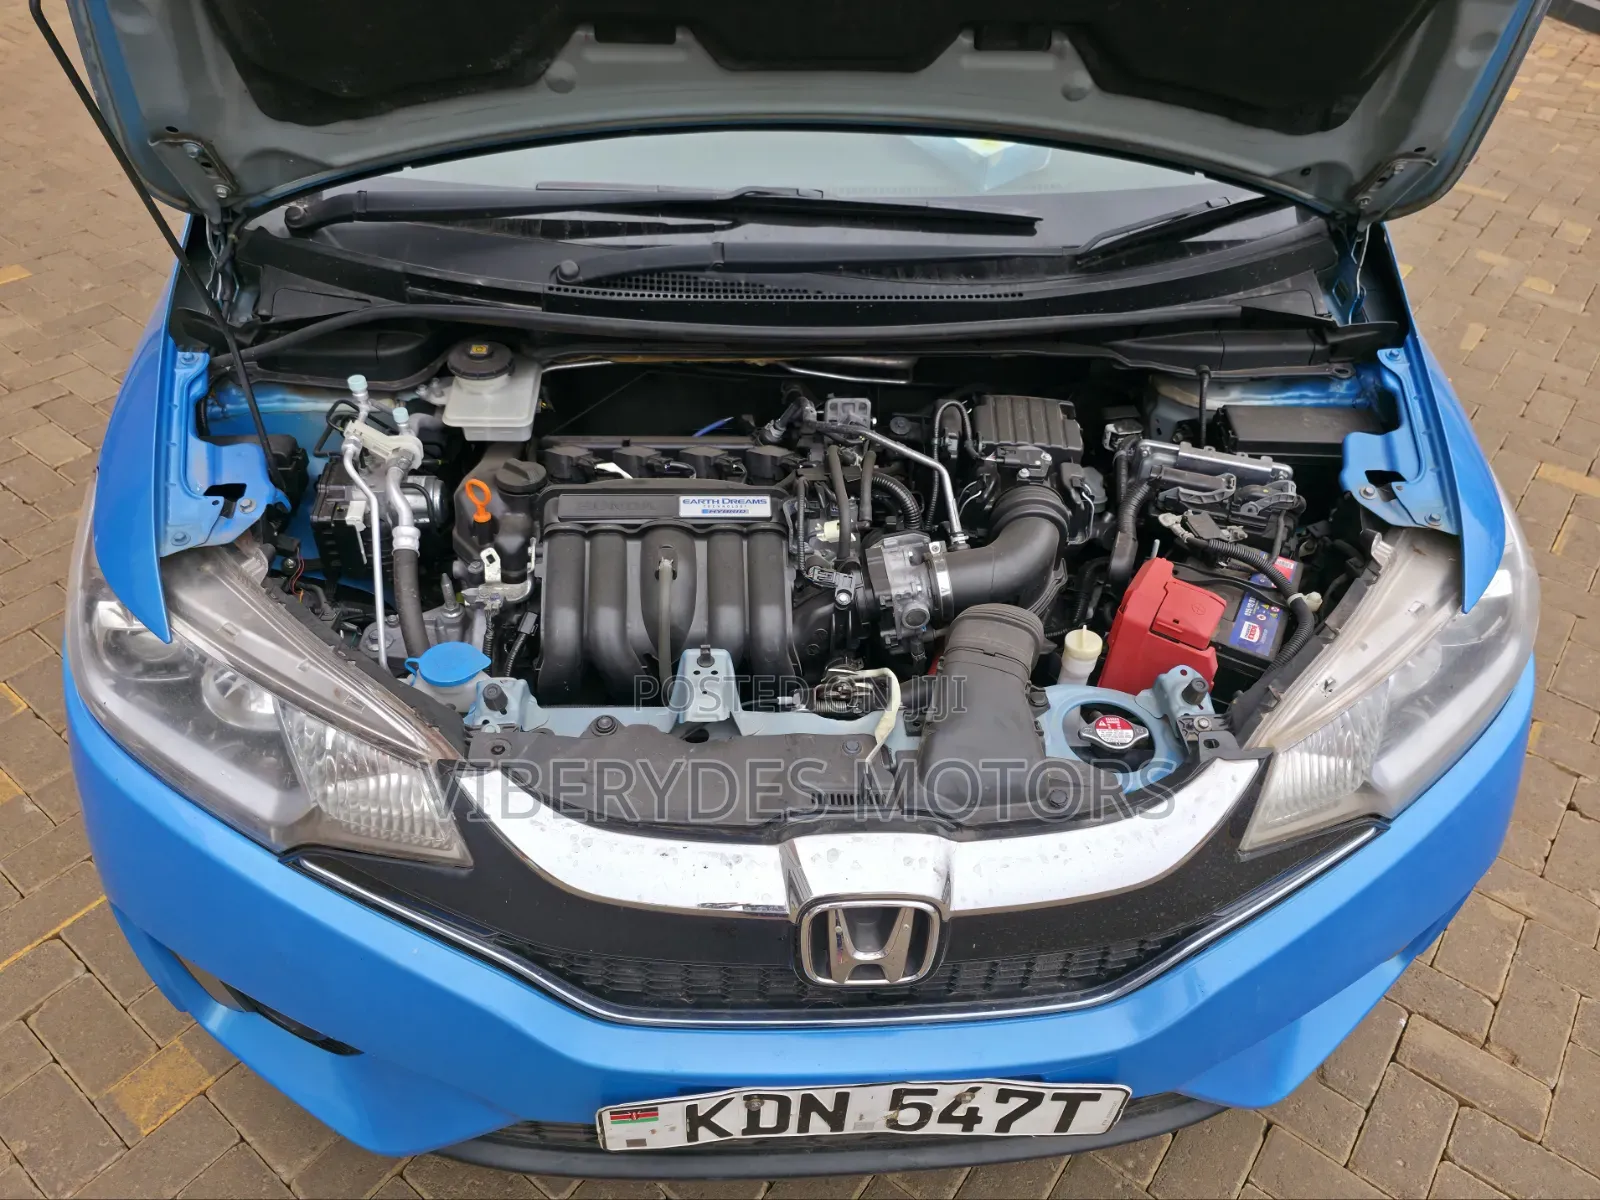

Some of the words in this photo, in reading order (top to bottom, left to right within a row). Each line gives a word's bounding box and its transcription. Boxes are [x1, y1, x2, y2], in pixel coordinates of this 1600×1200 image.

[721, 497, 768, 505] DREAMS
[685, 1091, 851, 1143] KDN
[886, 1086, 1103, 1133] 547T
